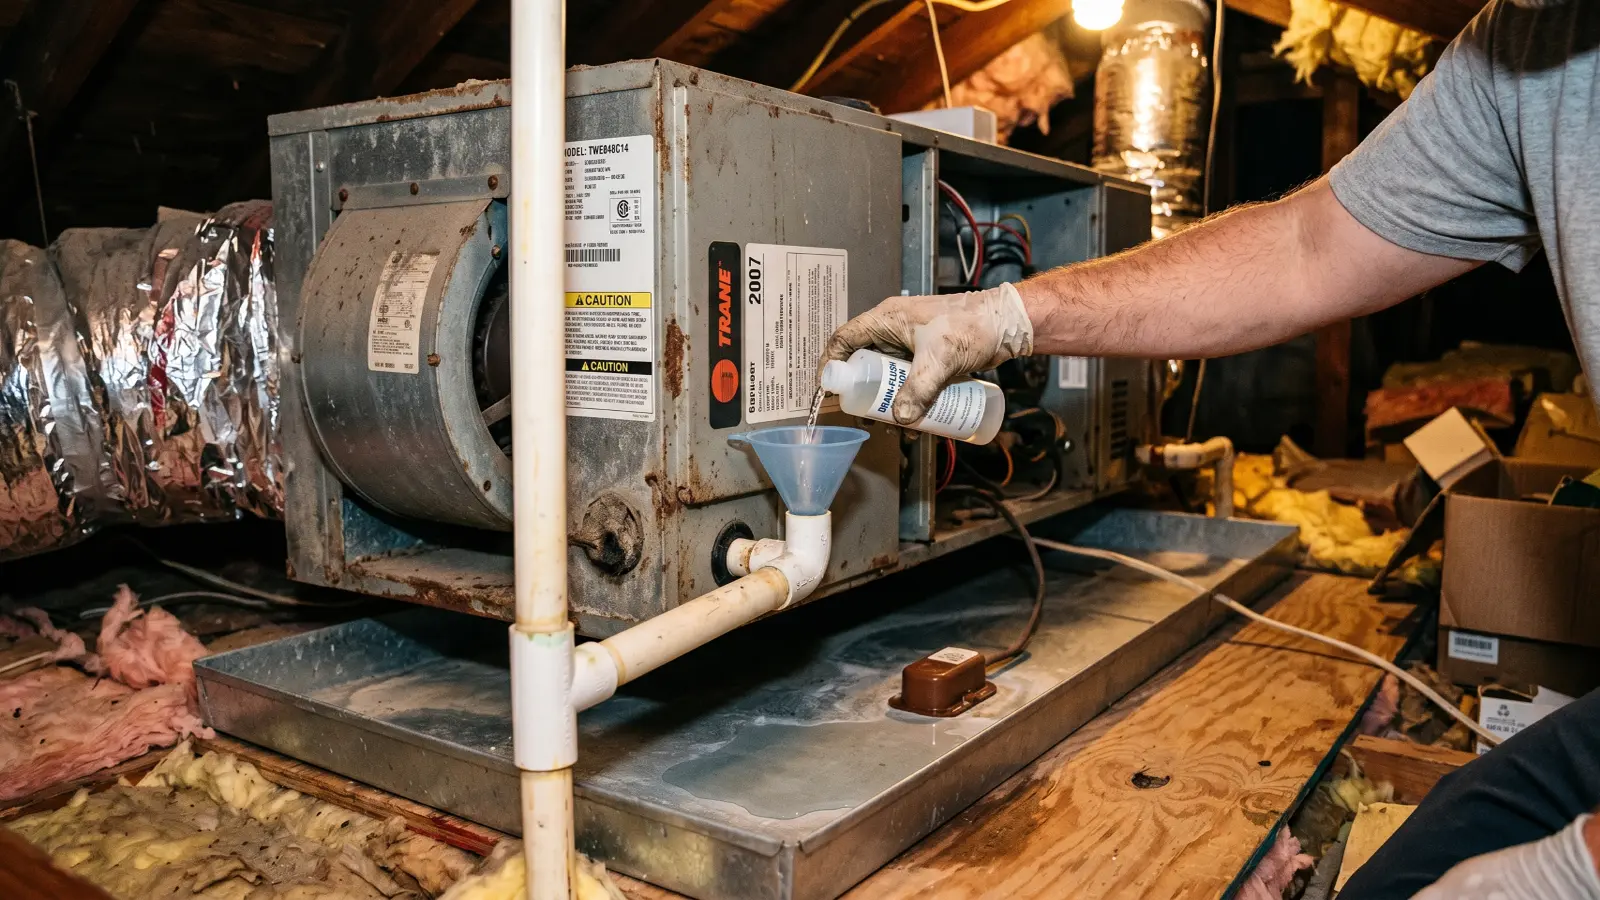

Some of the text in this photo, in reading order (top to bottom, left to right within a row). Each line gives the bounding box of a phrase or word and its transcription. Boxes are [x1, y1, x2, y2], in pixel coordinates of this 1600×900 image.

[749, 257, 762, 305] 2007
[585, 294, 632, 306] CAUTION
[718, 267, 732, 348] TRANE
[590, 361, 628, 373] CAUTION
